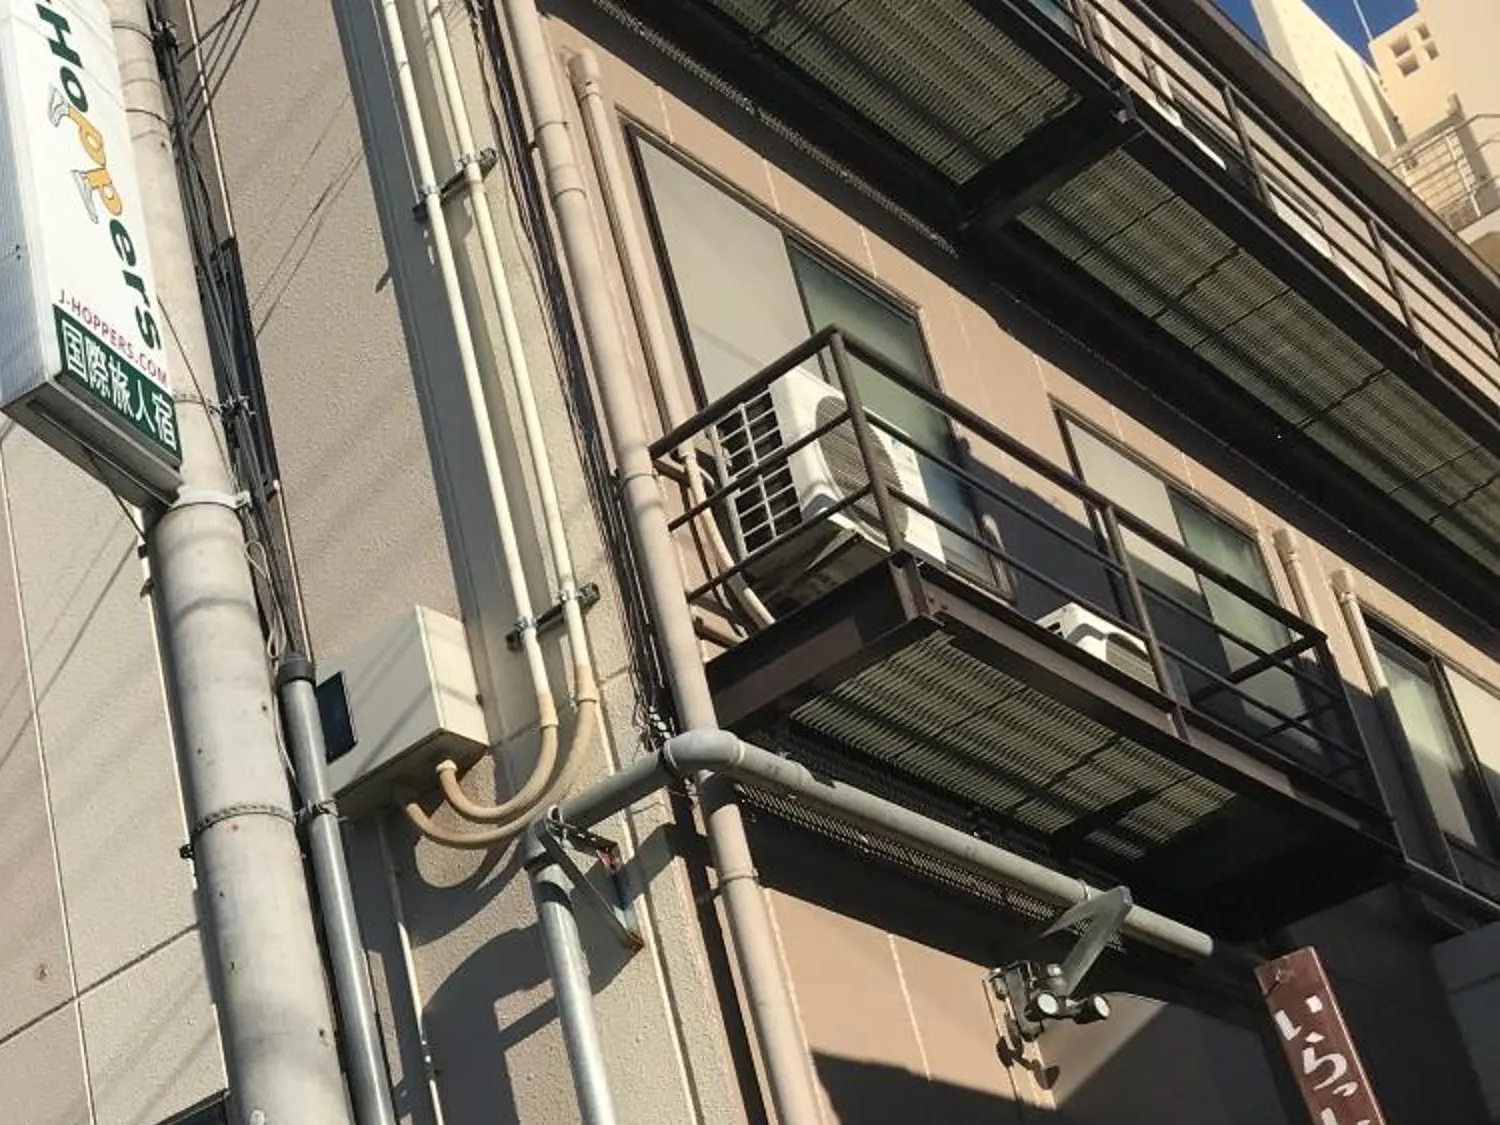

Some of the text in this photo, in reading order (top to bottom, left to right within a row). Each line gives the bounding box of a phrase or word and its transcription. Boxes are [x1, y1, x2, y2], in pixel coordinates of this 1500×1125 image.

[35, 0, 163, 349] Hoppers
[59, 289, 168, 382] J-HOPPERS.COM
[61, 319, 177, 451] 国際旅人宿
